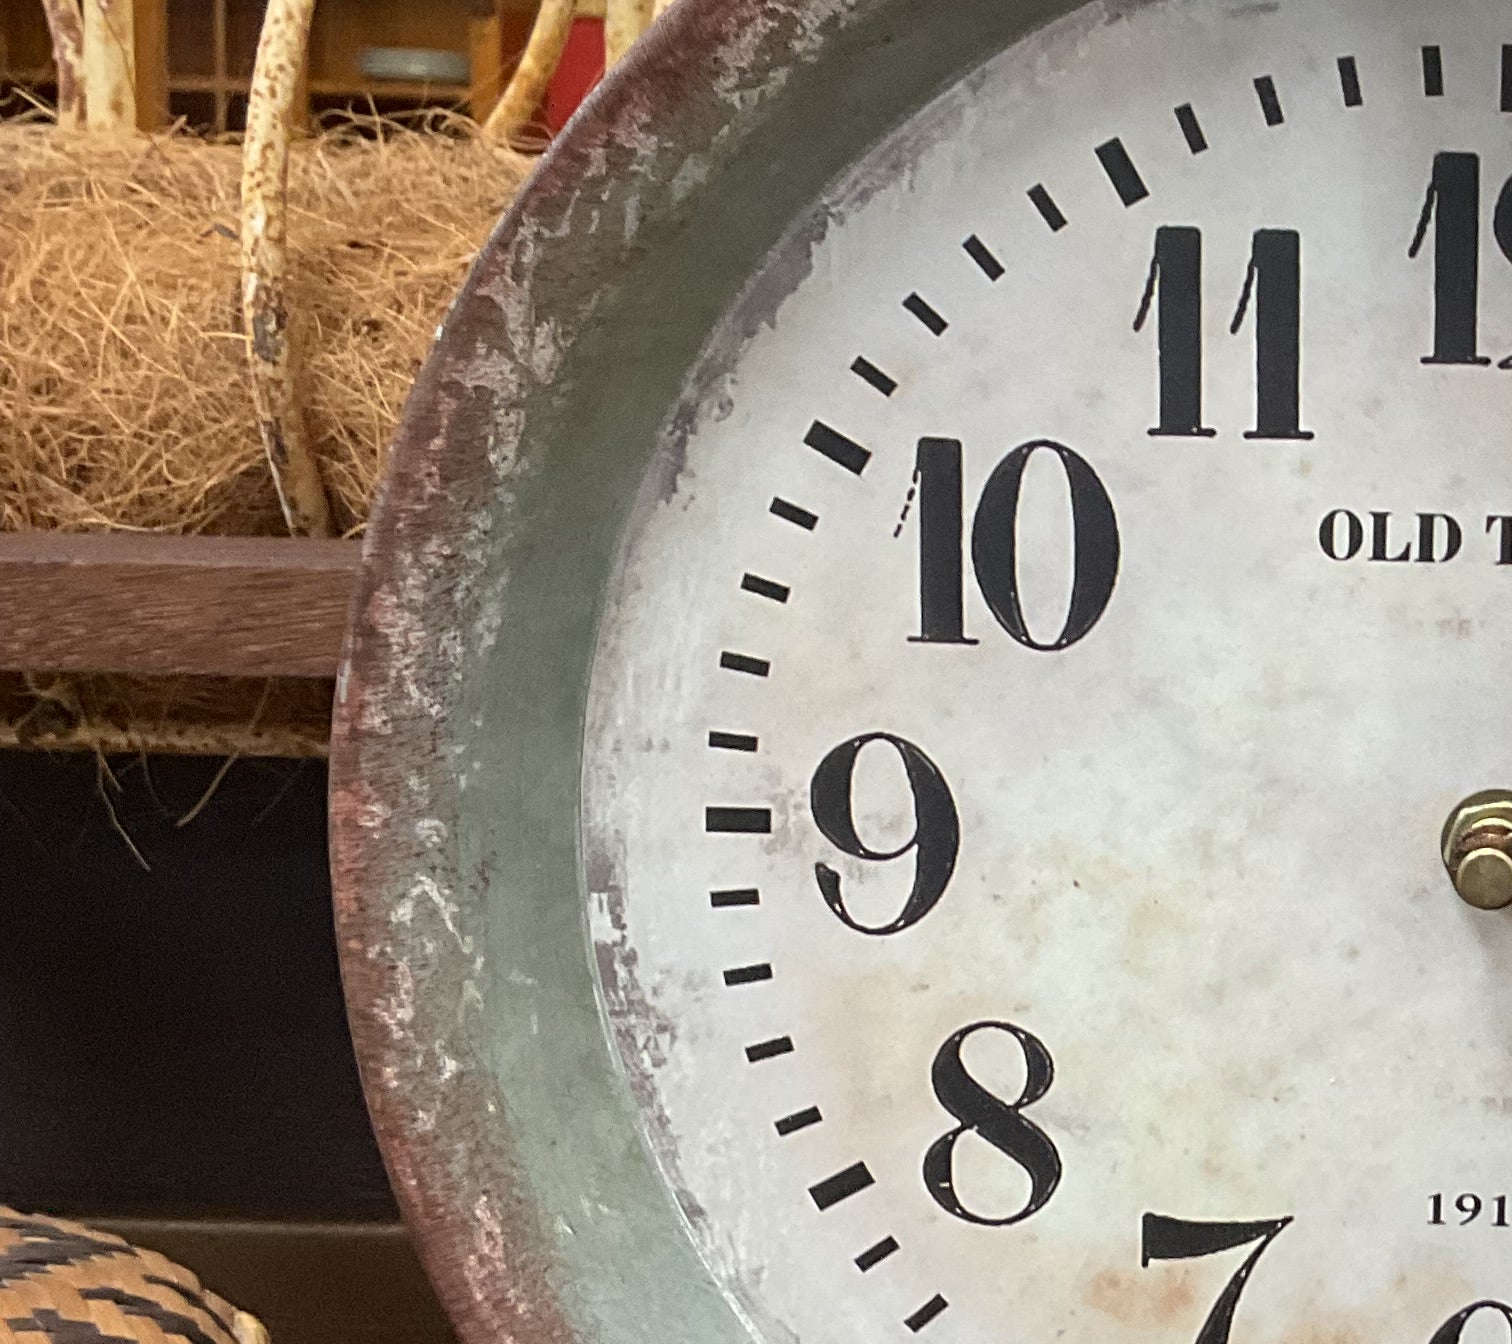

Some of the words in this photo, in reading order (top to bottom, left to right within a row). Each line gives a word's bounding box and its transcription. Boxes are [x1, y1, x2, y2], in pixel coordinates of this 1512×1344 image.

[1132, 226, 1315, 441] 11
[893, 436, 1121, 652] 10
[1319, 510, 1462, 563] OLD
[810, 732, 960, 936] 9
[922, 1021, 1063, 1227] 8
